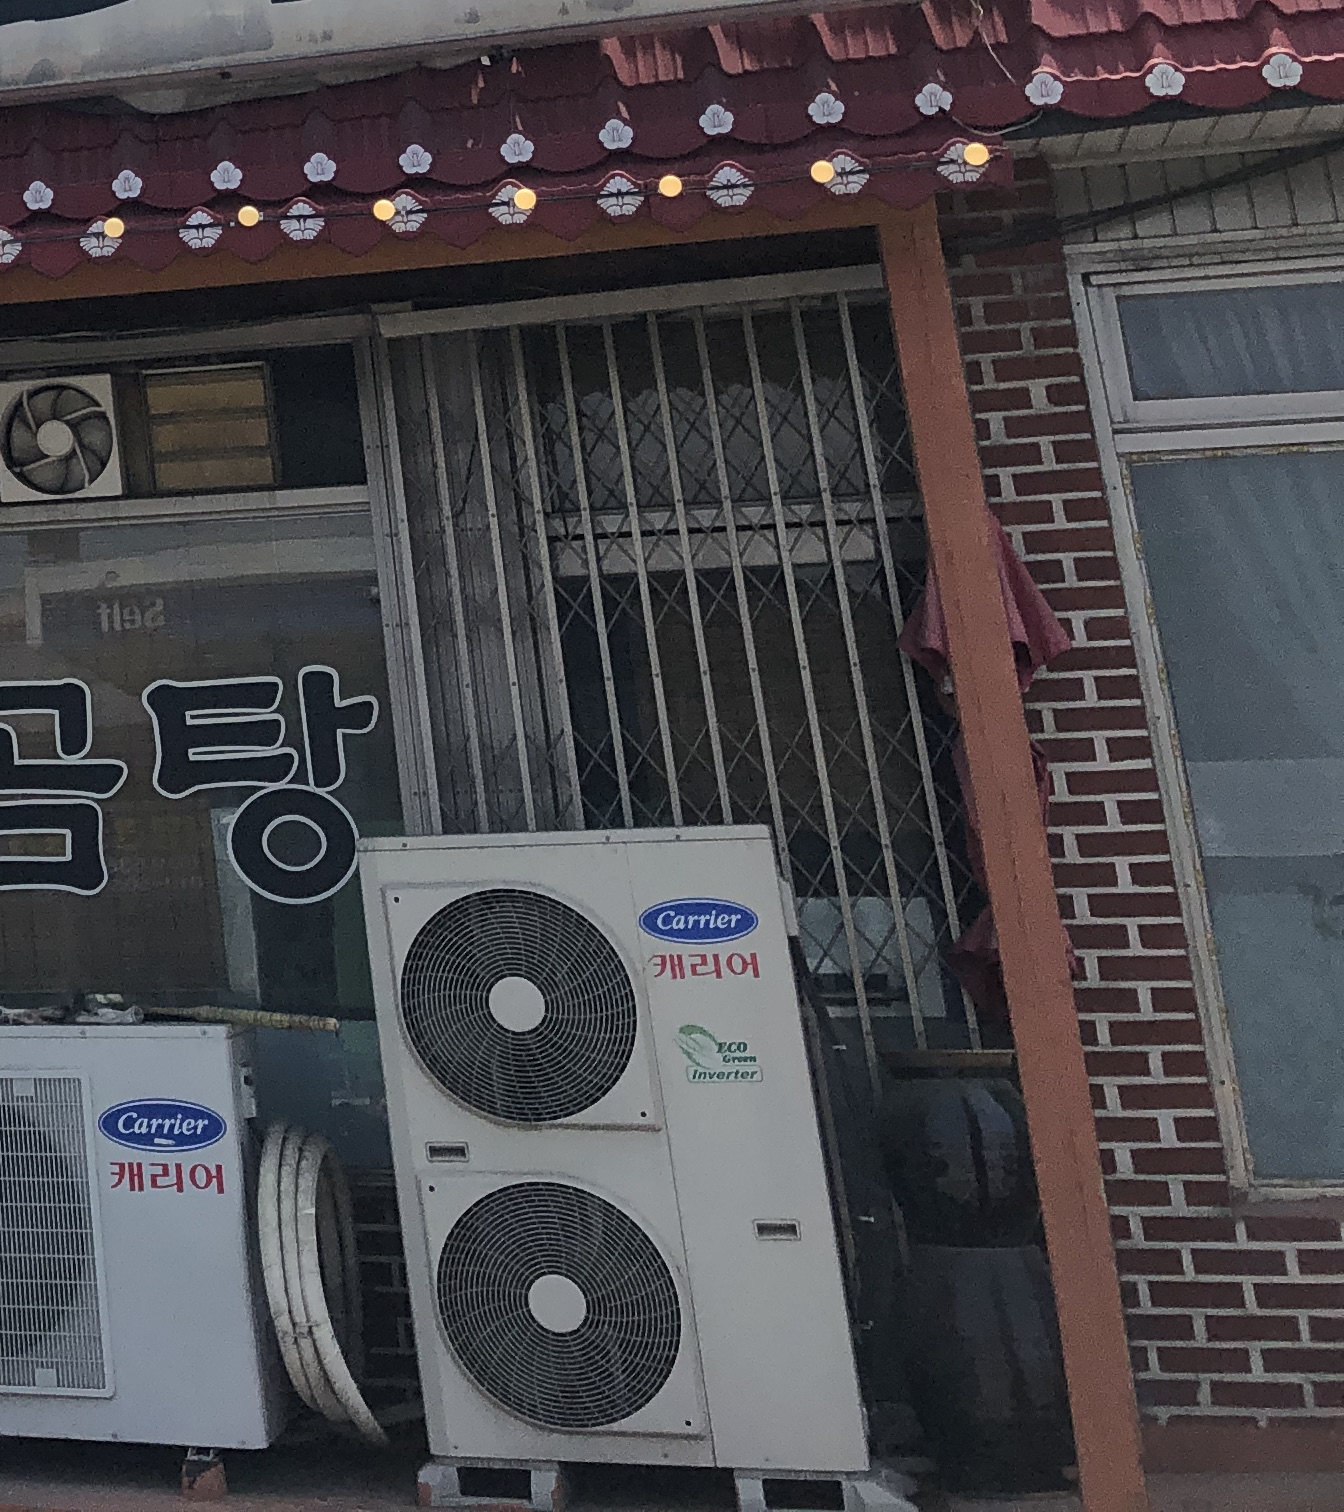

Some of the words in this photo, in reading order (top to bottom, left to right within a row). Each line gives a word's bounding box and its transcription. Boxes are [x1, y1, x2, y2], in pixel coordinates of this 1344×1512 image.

[656, 909, 742, 931] Carrier
[651, 951, 761, 980] 캐리어
[717, 1041, 748, 1055] ECO
[722, 1054, 757, 1064] Green
[691, 1068, 758, 1081] Inverter
[117, 1111, 209, 1136] Carrier
[109, 1161, 225, 1195] 캐리어
